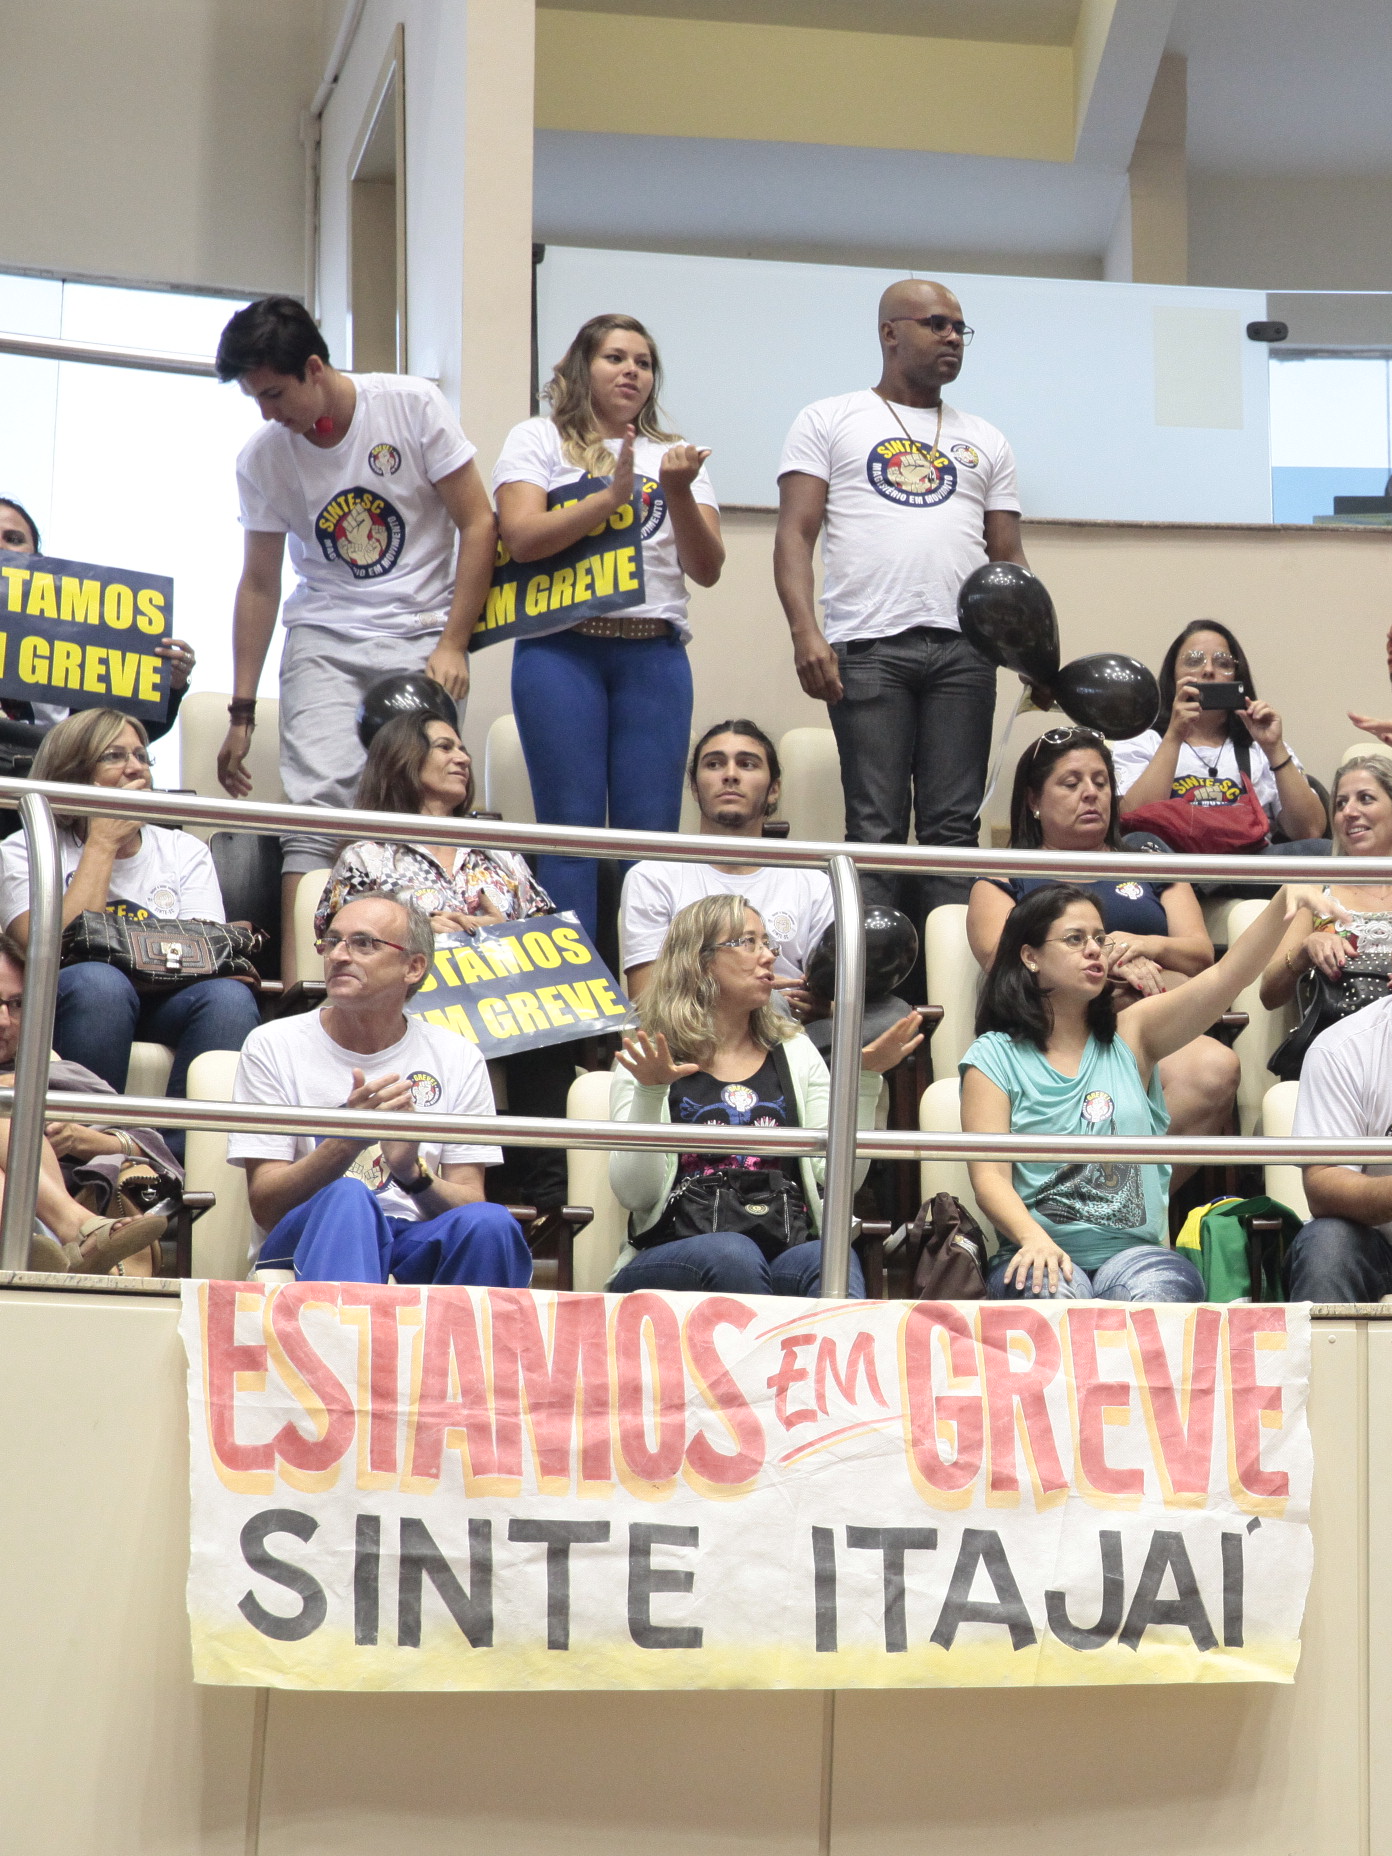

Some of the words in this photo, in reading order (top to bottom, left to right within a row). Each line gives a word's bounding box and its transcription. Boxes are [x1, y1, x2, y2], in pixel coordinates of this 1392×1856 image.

[318, 492, 386, 533] SINTE-SC
[872, 462, 908, 502] MAGISTÉRIO
[908, 494, 925, 505] EM
[368, 566, 384, 577] EM
[524, 546, 639, 617] GREVE
[18, 635, 163, 703] GREVE
[1172, 776, 1240, 800] SINTE-SC
[477, 978, 627, 1040] GREVE
[199, 1281, 767, 1502] ESTAMOS
[766, 1330, 890, 1432] EM
[899, 1300, 1291, 1519] GREVE
[238, 1507, 703, 1651] SINTE
[812, 1516, 1262, 1653] ITAJAÍ
